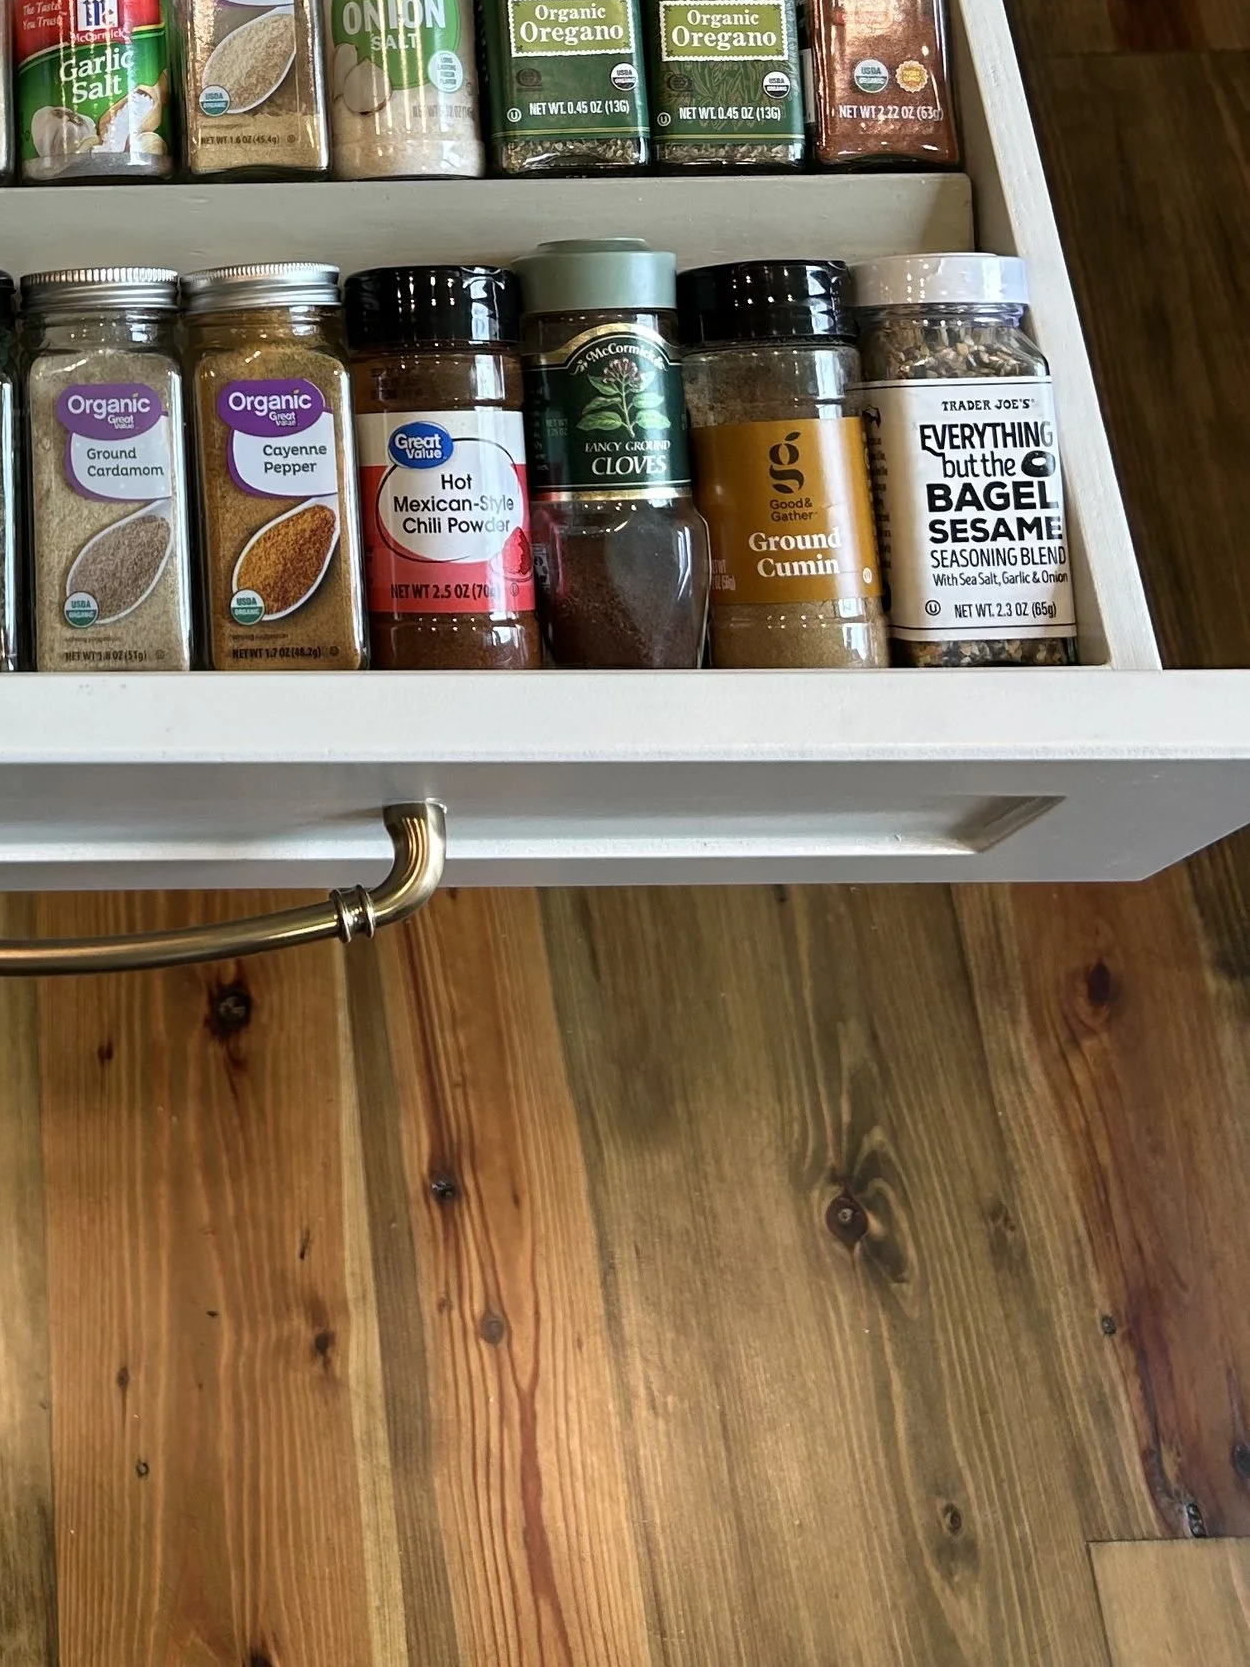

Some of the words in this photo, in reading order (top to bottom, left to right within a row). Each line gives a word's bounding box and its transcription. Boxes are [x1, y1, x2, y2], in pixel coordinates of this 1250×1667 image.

[534, 3, 606, 22] Organic
[687, 9, 759, 28] Organic
[370, 33, 419, 51] SALT
[520, 21, 624, 46] Oregano
[671, 25, 777, 51] Oregano
[60, 47, 134, 83] Garlic
[72, 74, 122, 103] Salt
[529, 102, 547, 115] NET
[547, 101, 567, 114] WT.
[567, 100, 588, 114] 0.45
[590, 100, 603, 114] OZ
[604, 99, 630, 115] (13G)
[67, 394, 151, 419] Organic
[228, 390, 312, 416] Organic
[942, 400, 992, 412] TRADER
[994, 399, 1031, 410] JOE'S
[393, 432, 442, 451] Great
[585, 440, 622, 453] FANCY
[625, 439, 671, 452] GROUND
[919, 421, 1054, 454] EVERYTHING
[86, 447, 137, 461] Ground
[262, 444, 328, 462] Cayenne
[405, 447, 443, 460] Value
[87, 463, 165, 478] Cardamom
[263, 461, 318, 476] Pepper
[591, 455, 667, 476] CLOVES
[941, 452, 978, 478] but
[981, 451, 1016, 478] the
[440, 473, 472, 491] Hot
[926, 481, 1059, 513] BAGEL
[393, 494, 515, 521] Mexican-Style
[771, 510, 814, 523] Gather
[402, 516, 442, 535] Chili
[448, 516, 510, 535] Powder
[929, 516, 1063, 544] SESAME
[748, 526, 843, 553] Ground
[756, 554, 840, 578] Cumin
[930, 548, 1018, 569] SEASONING
[1021, 546, 1067, 566] BLEND
[933, 573, 958, 587] With
[960, 573, 978, 587] Sea
[978, 572, 1002, 588] Salt,
[1002, 571, 1031, 585] Garlic
[1032, 571, 1041, 584] &
[1041, 570, 1069, 585] Onion
[71, 599, 91, 609] USDA
[236, 596, 257, 606] USDA
[954, 604, 973, 618] NET
[975, 604, 996, 618] WT.
[996, 604, 1013, 618] 2.3
[1015, 603, 1029, 617] OZ
[1031, 602, 1058, 619] (65g)
